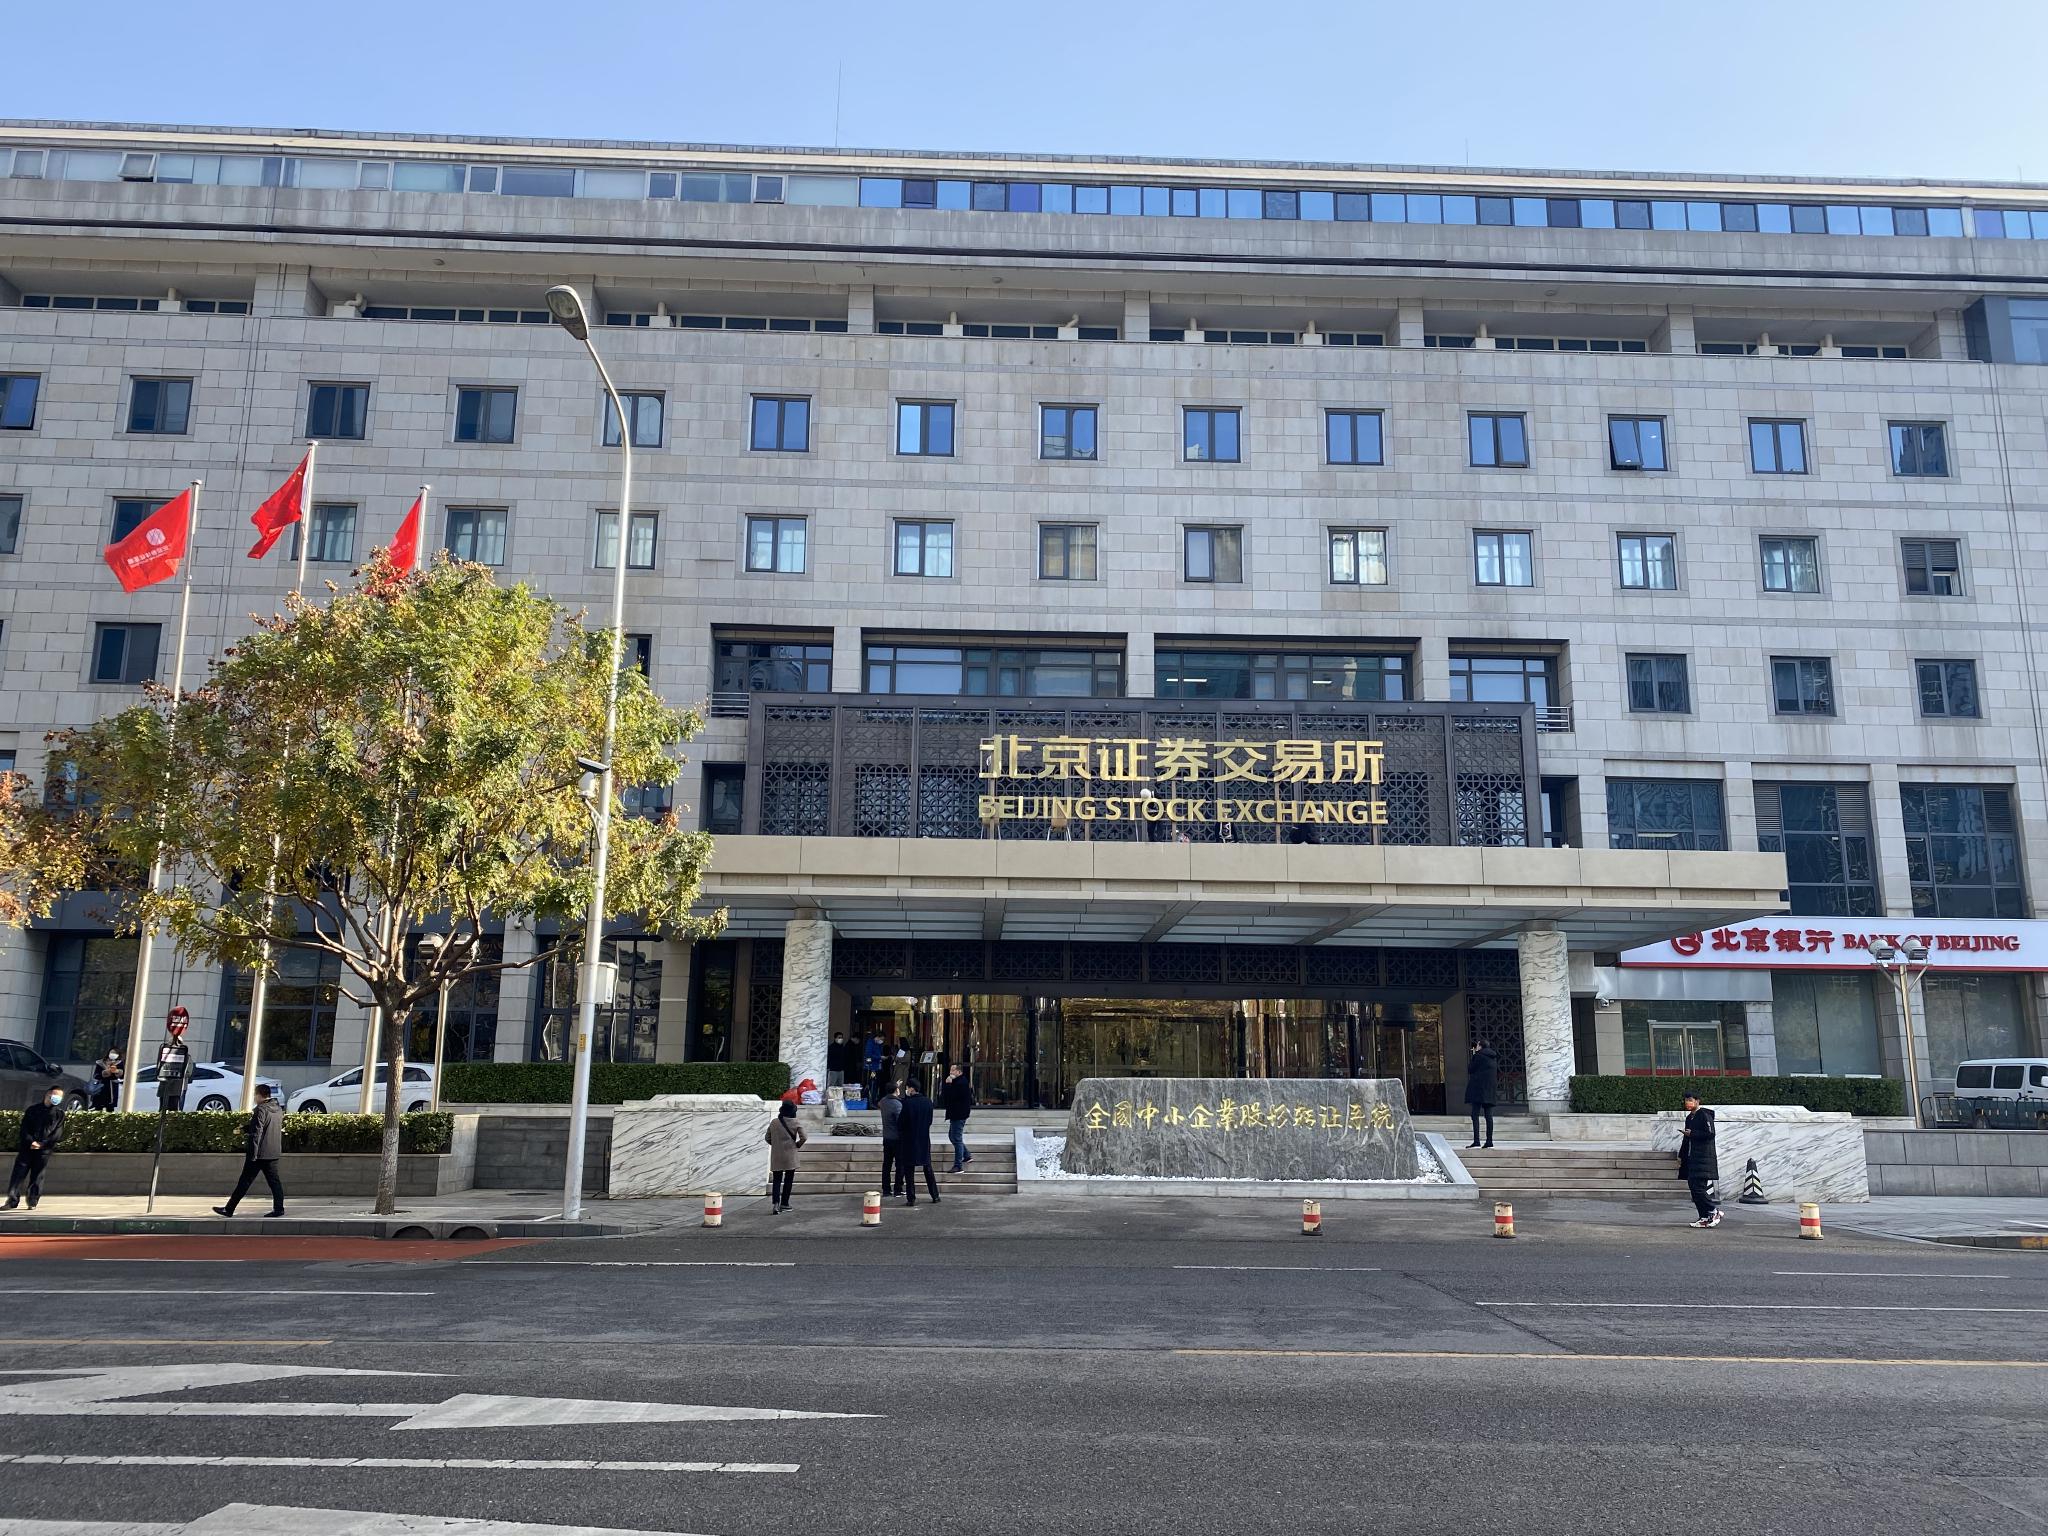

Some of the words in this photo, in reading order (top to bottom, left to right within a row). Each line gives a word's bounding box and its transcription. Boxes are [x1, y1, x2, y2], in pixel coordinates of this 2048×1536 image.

[978, 734, 1385, 784] 北京证券交易所
[979, 795, 1096, 821] BEIJING
[1105, 797, 1207, 822] STOCK
[1216, 798, 1388, 824] EXCHANGE
[1935, 935, 2020, 952] BEIJING
